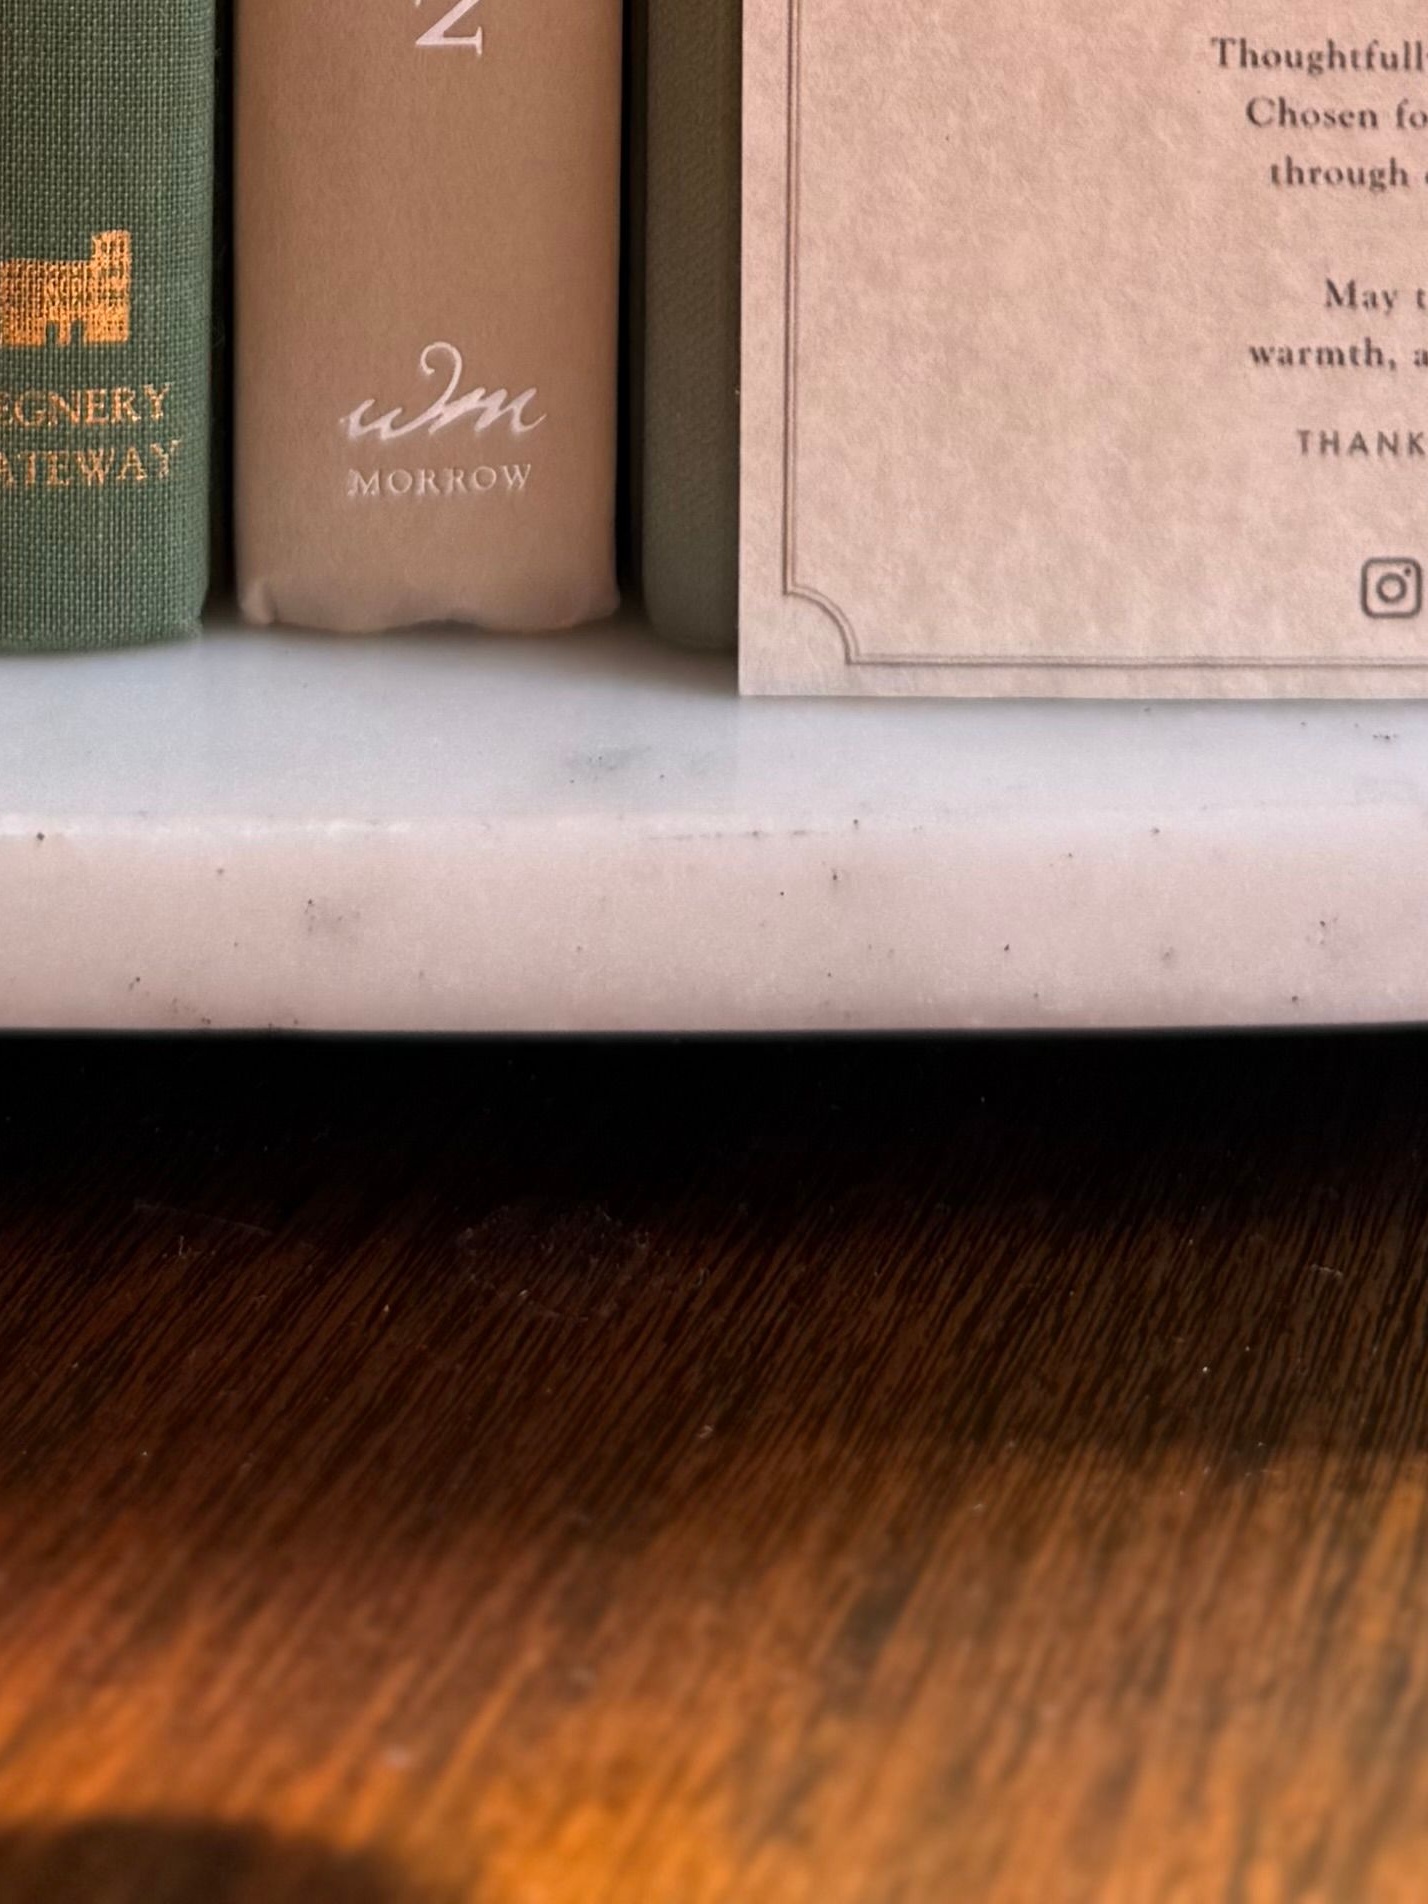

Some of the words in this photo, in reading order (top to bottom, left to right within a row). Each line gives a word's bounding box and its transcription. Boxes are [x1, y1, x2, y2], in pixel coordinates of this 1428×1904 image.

[1245, 96, 1379, 132] Chosen
[1269, 154, 1410, 196] through
[1324, 277, 1399, 316] May
[1247, 335, 1398, 374] warmth,
[1296, 429, 1426, 459] THANK
[348, 462, 533, 496] MORROW
